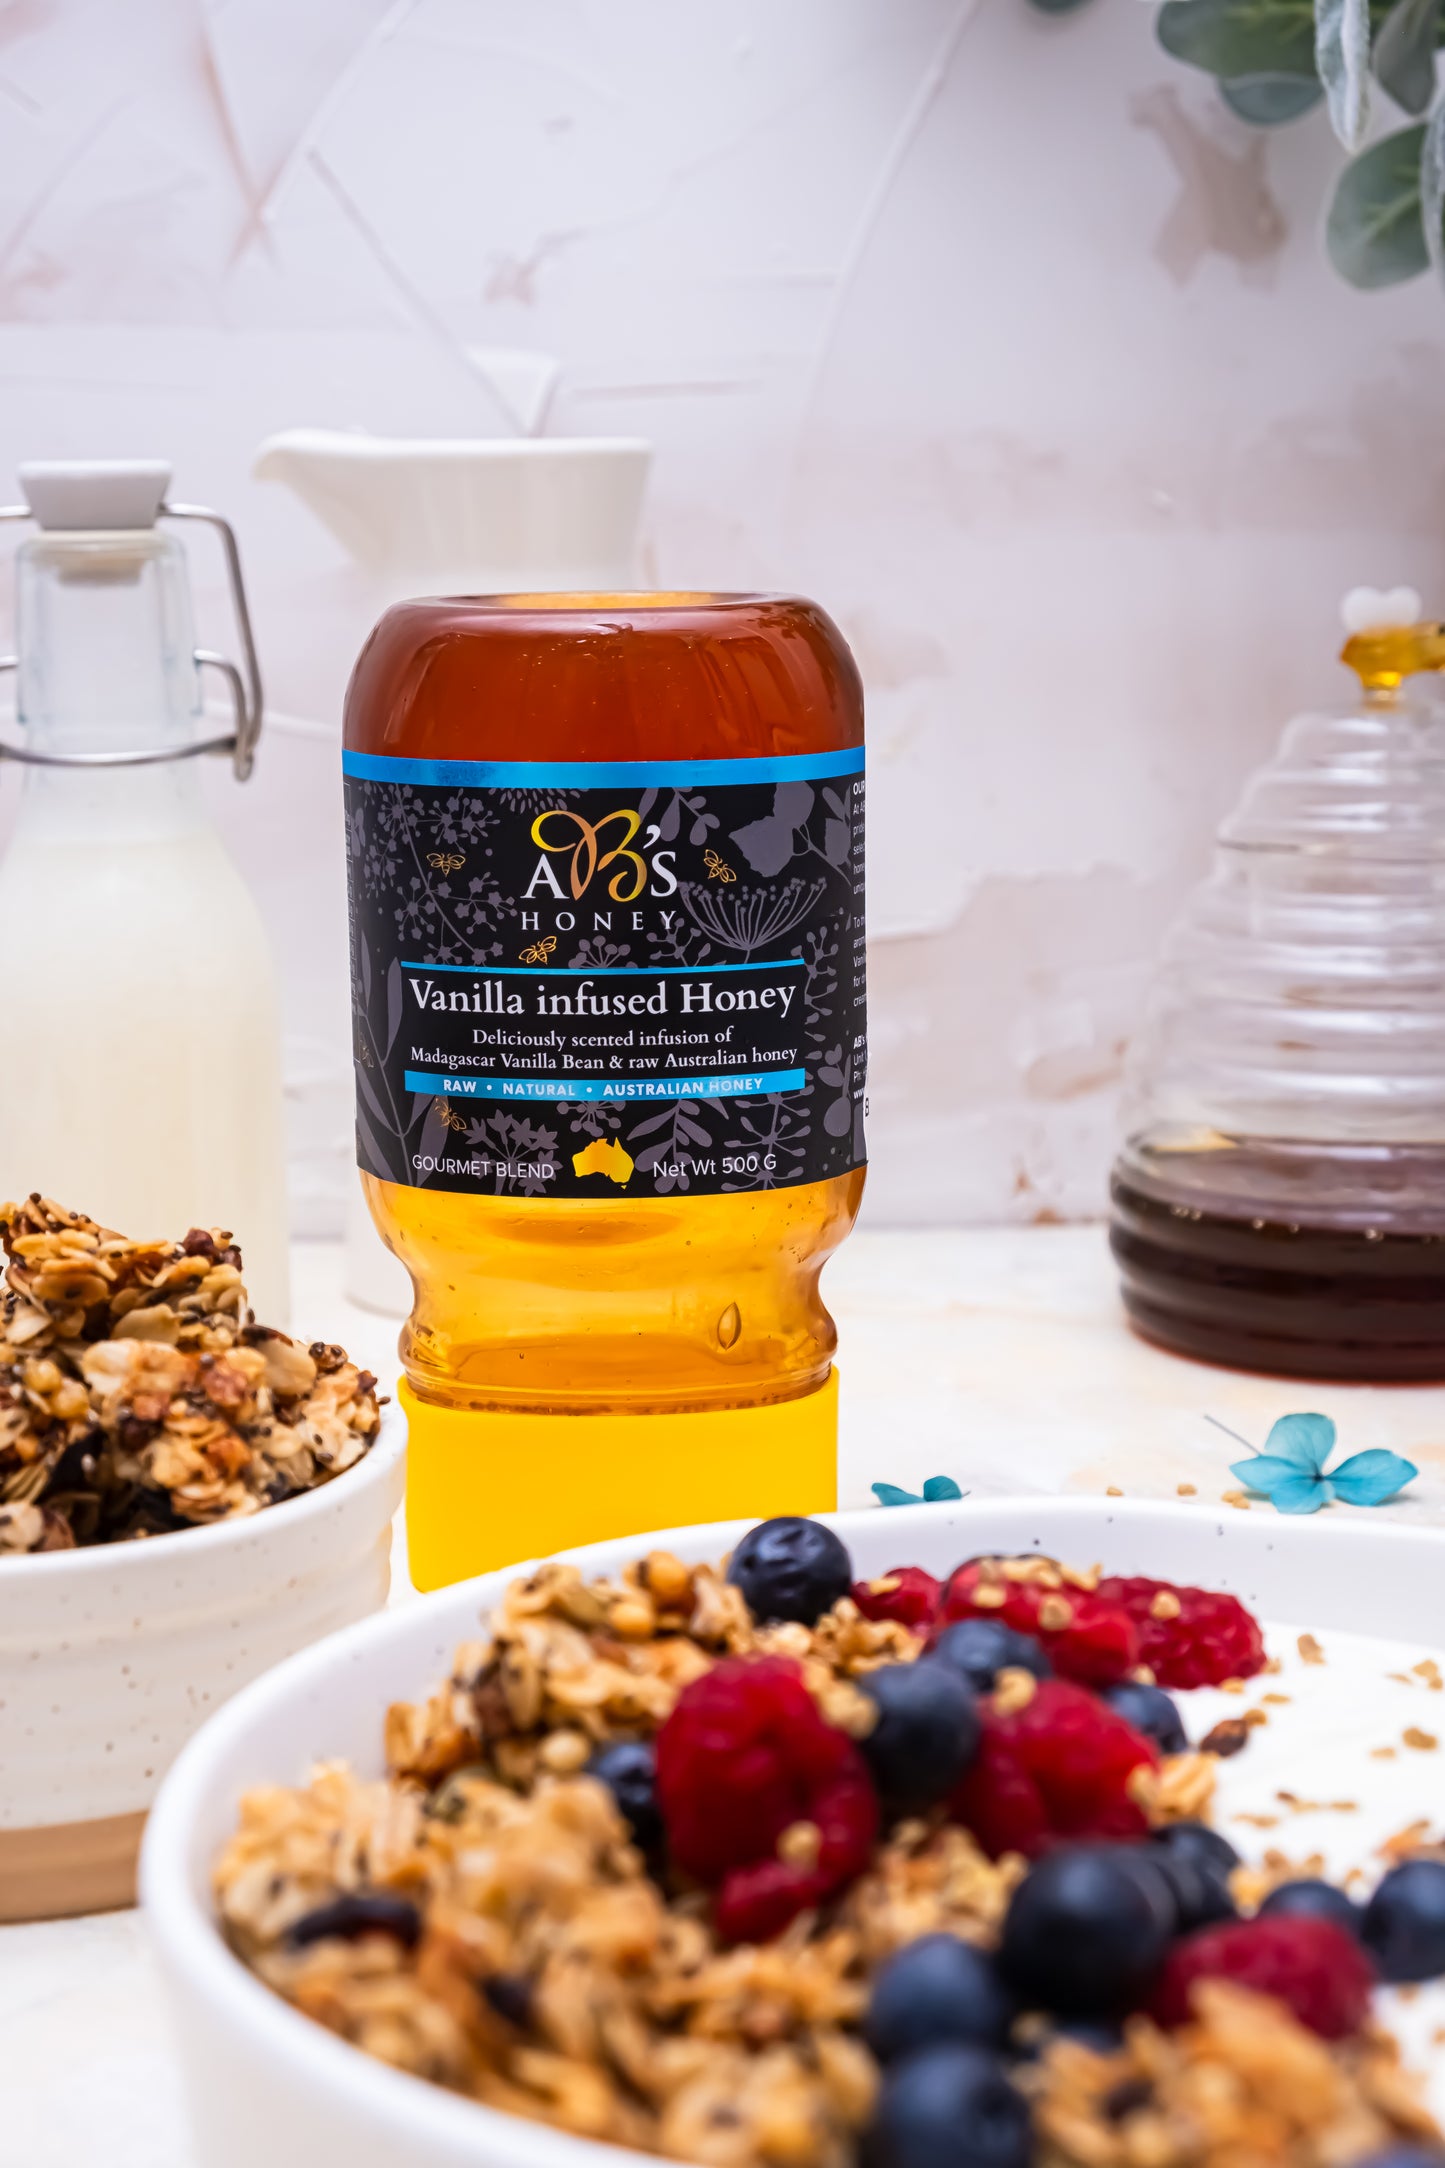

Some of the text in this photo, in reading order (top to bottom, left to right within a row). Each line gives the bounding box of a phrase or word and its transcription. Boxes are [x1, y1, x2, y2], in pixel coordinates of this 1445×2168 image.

[520, 911, 677, 931] HONEY
[408, 978, 797, 1018] Vanilla infused Honey
[472, 1025, 735, 1051] Deliciously scented infusion of
[410, 1046, 798, 1070] Madagascar Vanilla Bean & raw Australian honey
[443, 1077, 763, 1097] RAW NATURAL AUSTRALIAN HONEY
[412, 1154, 555, 1179] GOURMET BLEND
[653, 1153, 777, 1178] Net Wt 500 G
